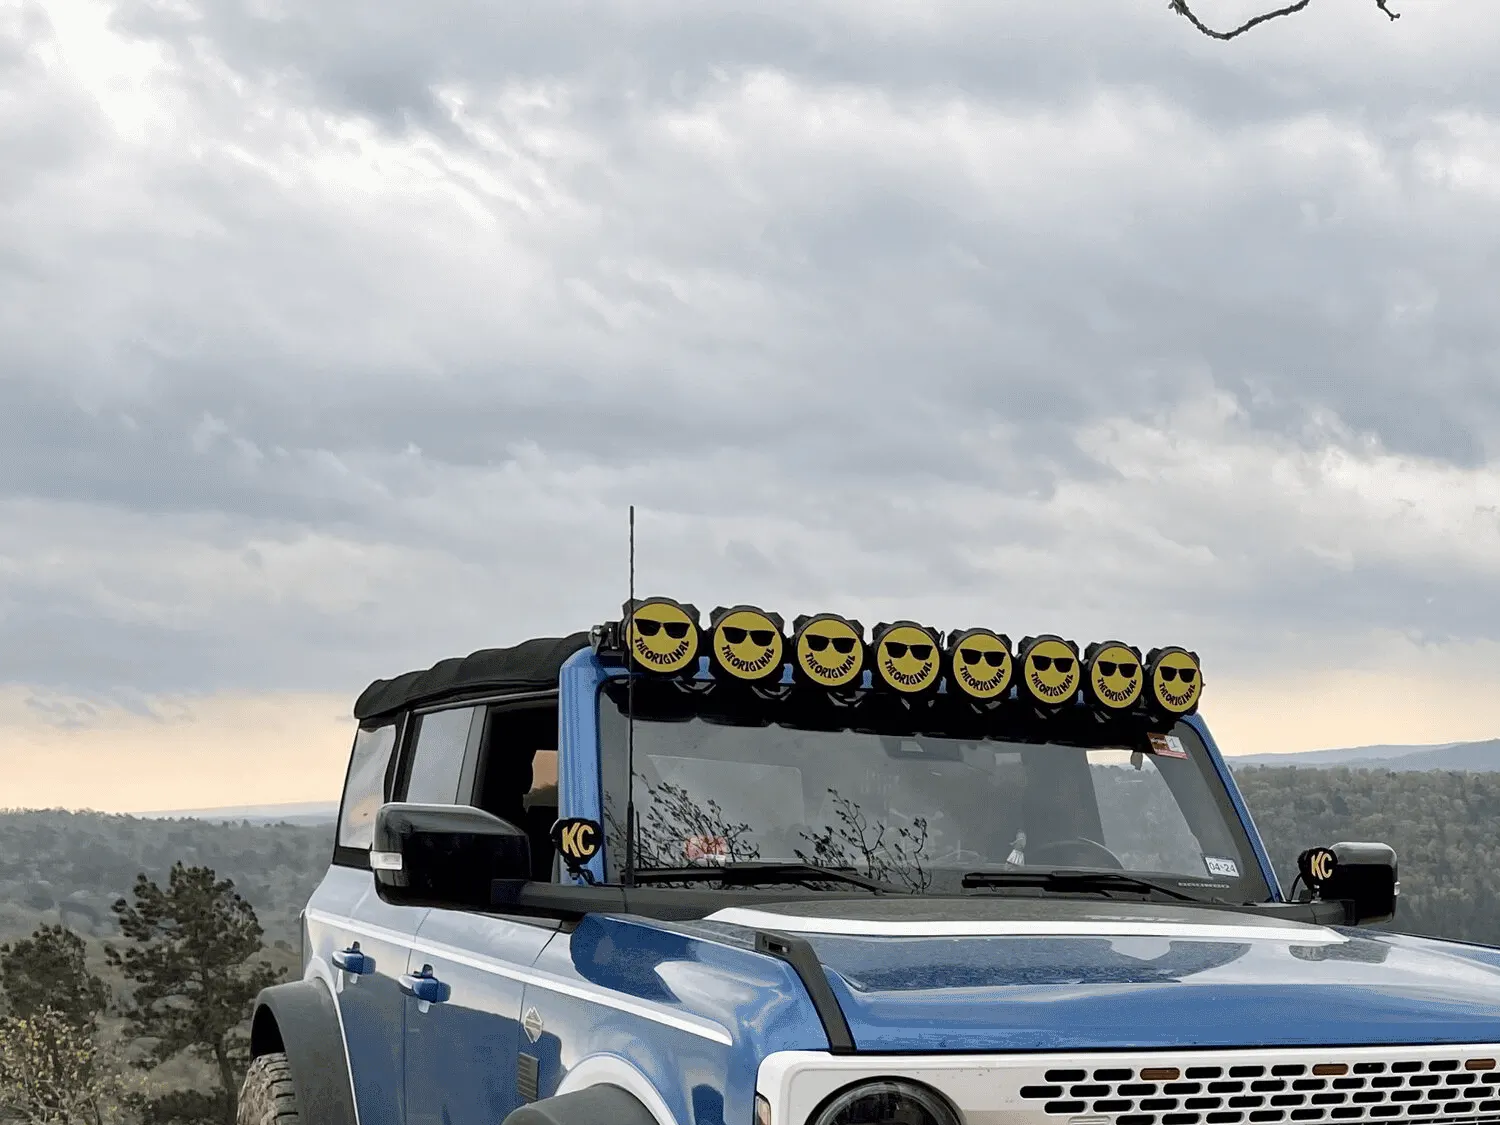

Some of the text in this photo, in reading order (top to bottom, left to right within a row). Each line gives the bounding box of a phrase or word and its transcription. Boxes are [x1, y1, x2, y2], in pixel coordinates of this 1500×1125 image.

[635, 638, 689, 664] THE ORIGINAL
[722, 645, 774, 672] THE ORIGINAL
[805, 652, 855, 678] THE ORIGINAL
[885, 659, 932, 685] THE ORIGINAL
[960, 666, 1005, 691] THE ORIGINAL
[1031, 672, 1073, 696] THE ORIGINAL
[1097, 678, 1137, 701] THE ORIGINAL
[1159, 683, 1195, 706] THE ORIGINAL
[561, 822, 596, 858] KC
[1310, 851, 1333, 880] KC
